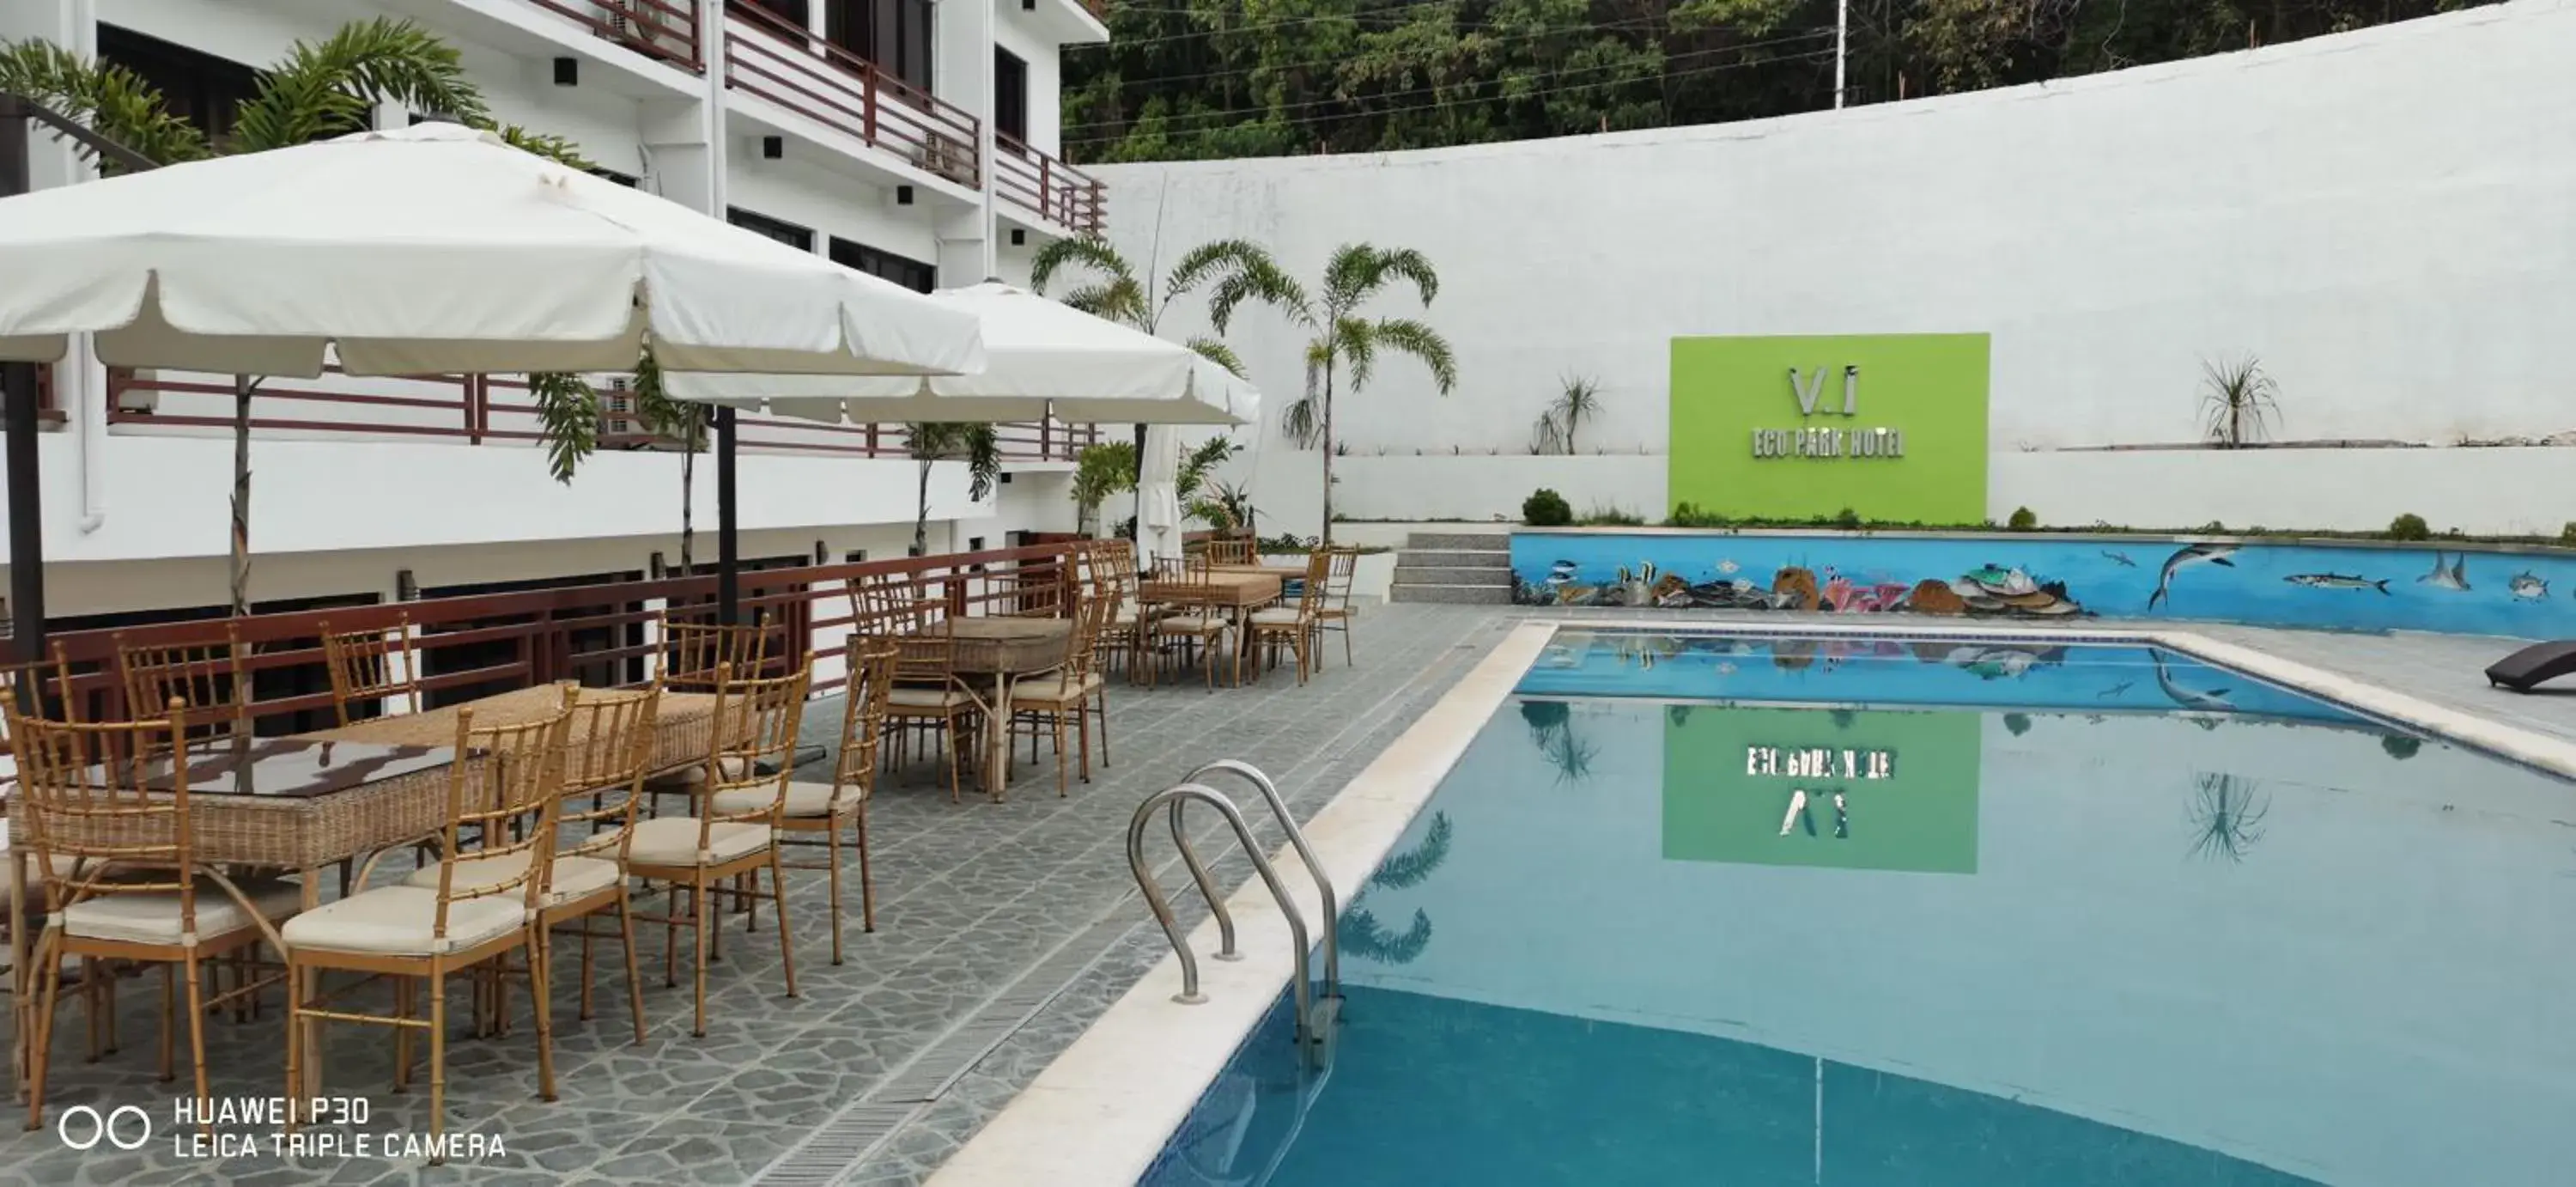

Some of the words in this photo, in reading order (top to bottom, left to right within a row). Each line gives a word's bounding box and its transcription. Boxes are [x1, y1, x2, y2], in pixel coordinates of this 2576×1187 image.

[1753, 429, 1788, 458] ECO
[1795, 428, 1843, 458] PARK
[1850, 428, 1904, 458] HOTEL
